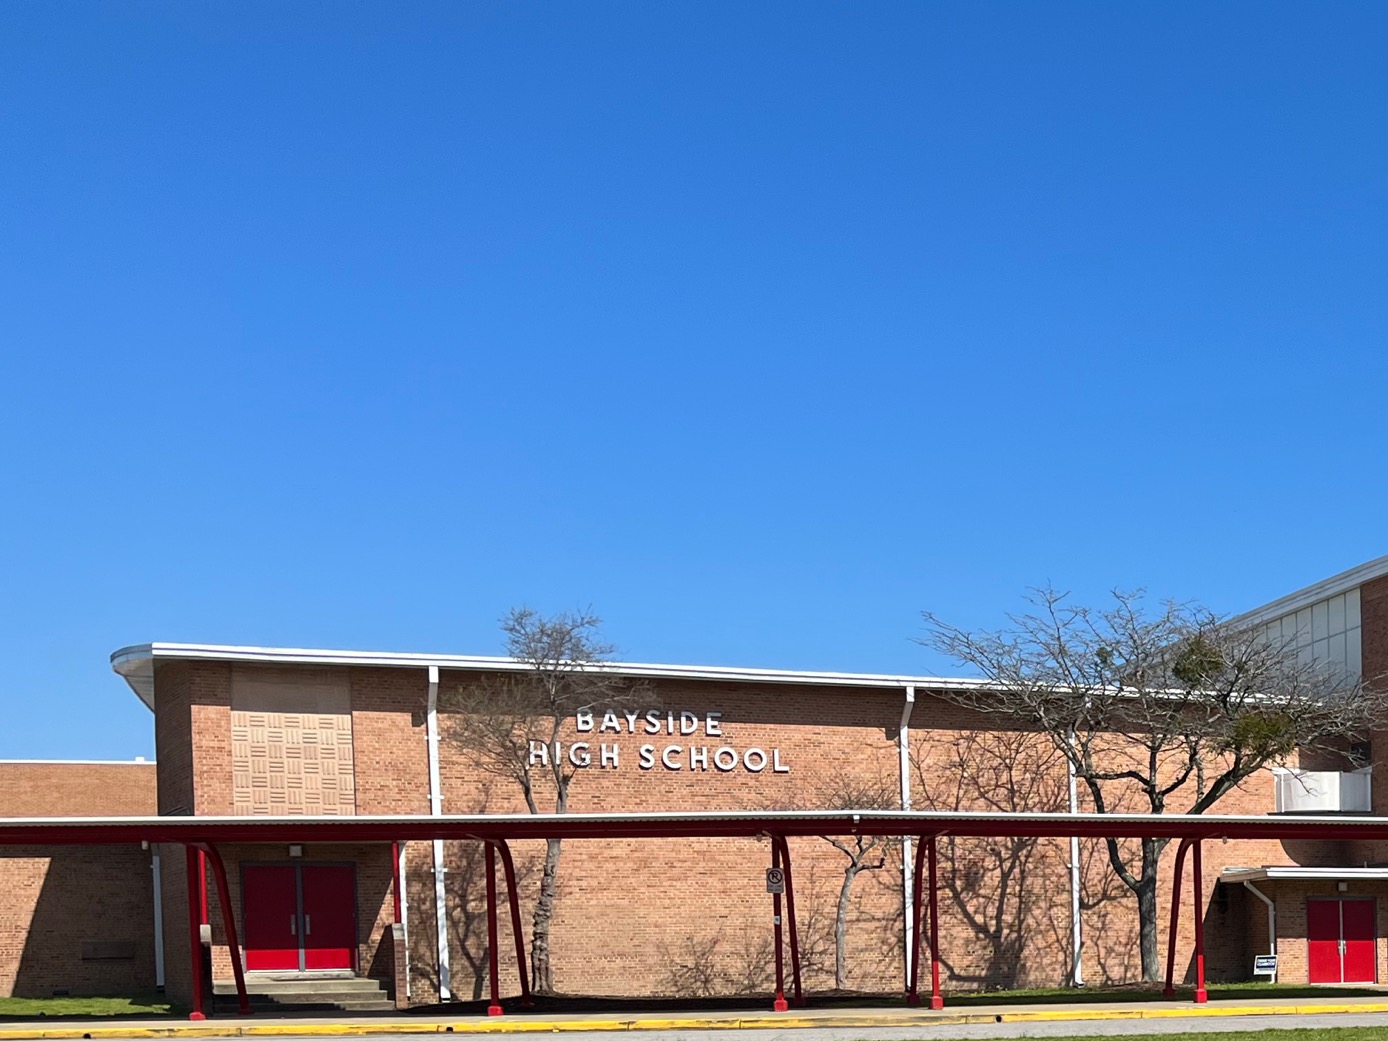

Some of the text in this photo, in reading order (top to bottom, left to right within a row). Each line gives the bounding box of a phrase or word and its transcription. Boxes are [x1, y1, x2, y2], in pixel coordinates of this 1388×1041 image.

[576, 708, 723, 736] BAYSIDE
[529, 740, 790, 773] HIGH SCHOOL
